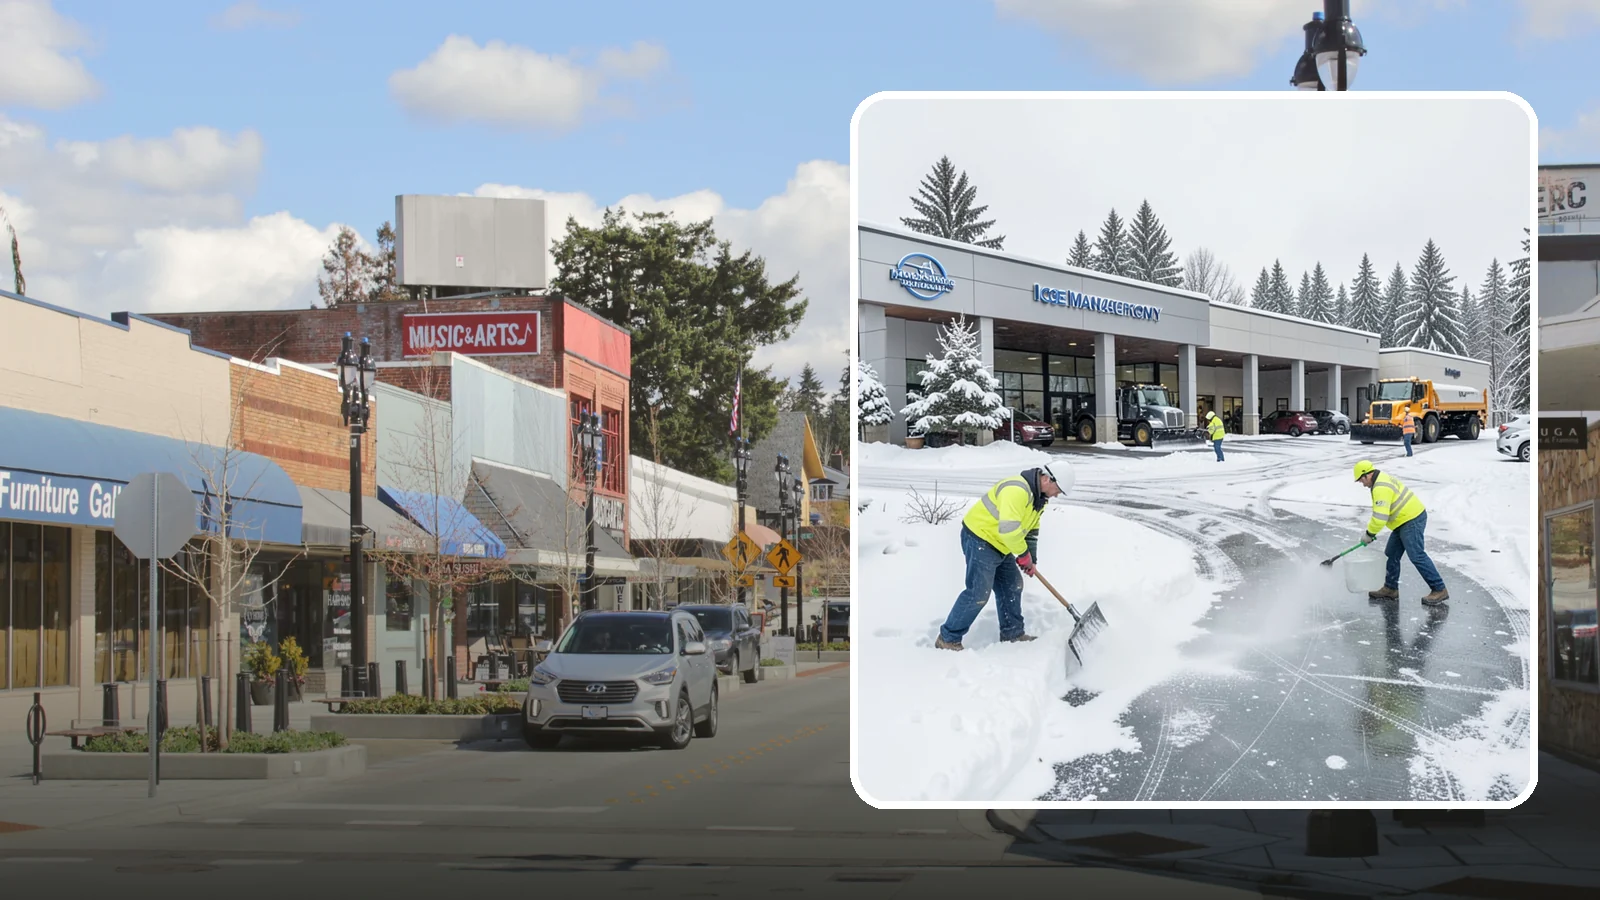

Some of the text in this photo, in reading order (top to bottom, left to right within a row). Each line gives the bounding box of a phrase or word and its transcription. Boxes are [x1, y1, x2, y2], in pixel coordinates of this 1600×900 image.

[409, 323, 520, 349] MUSIC&ARTS
[0, 471, 122, 519] Furniture Gal
[453, 563, 480, 574] SUSHI
